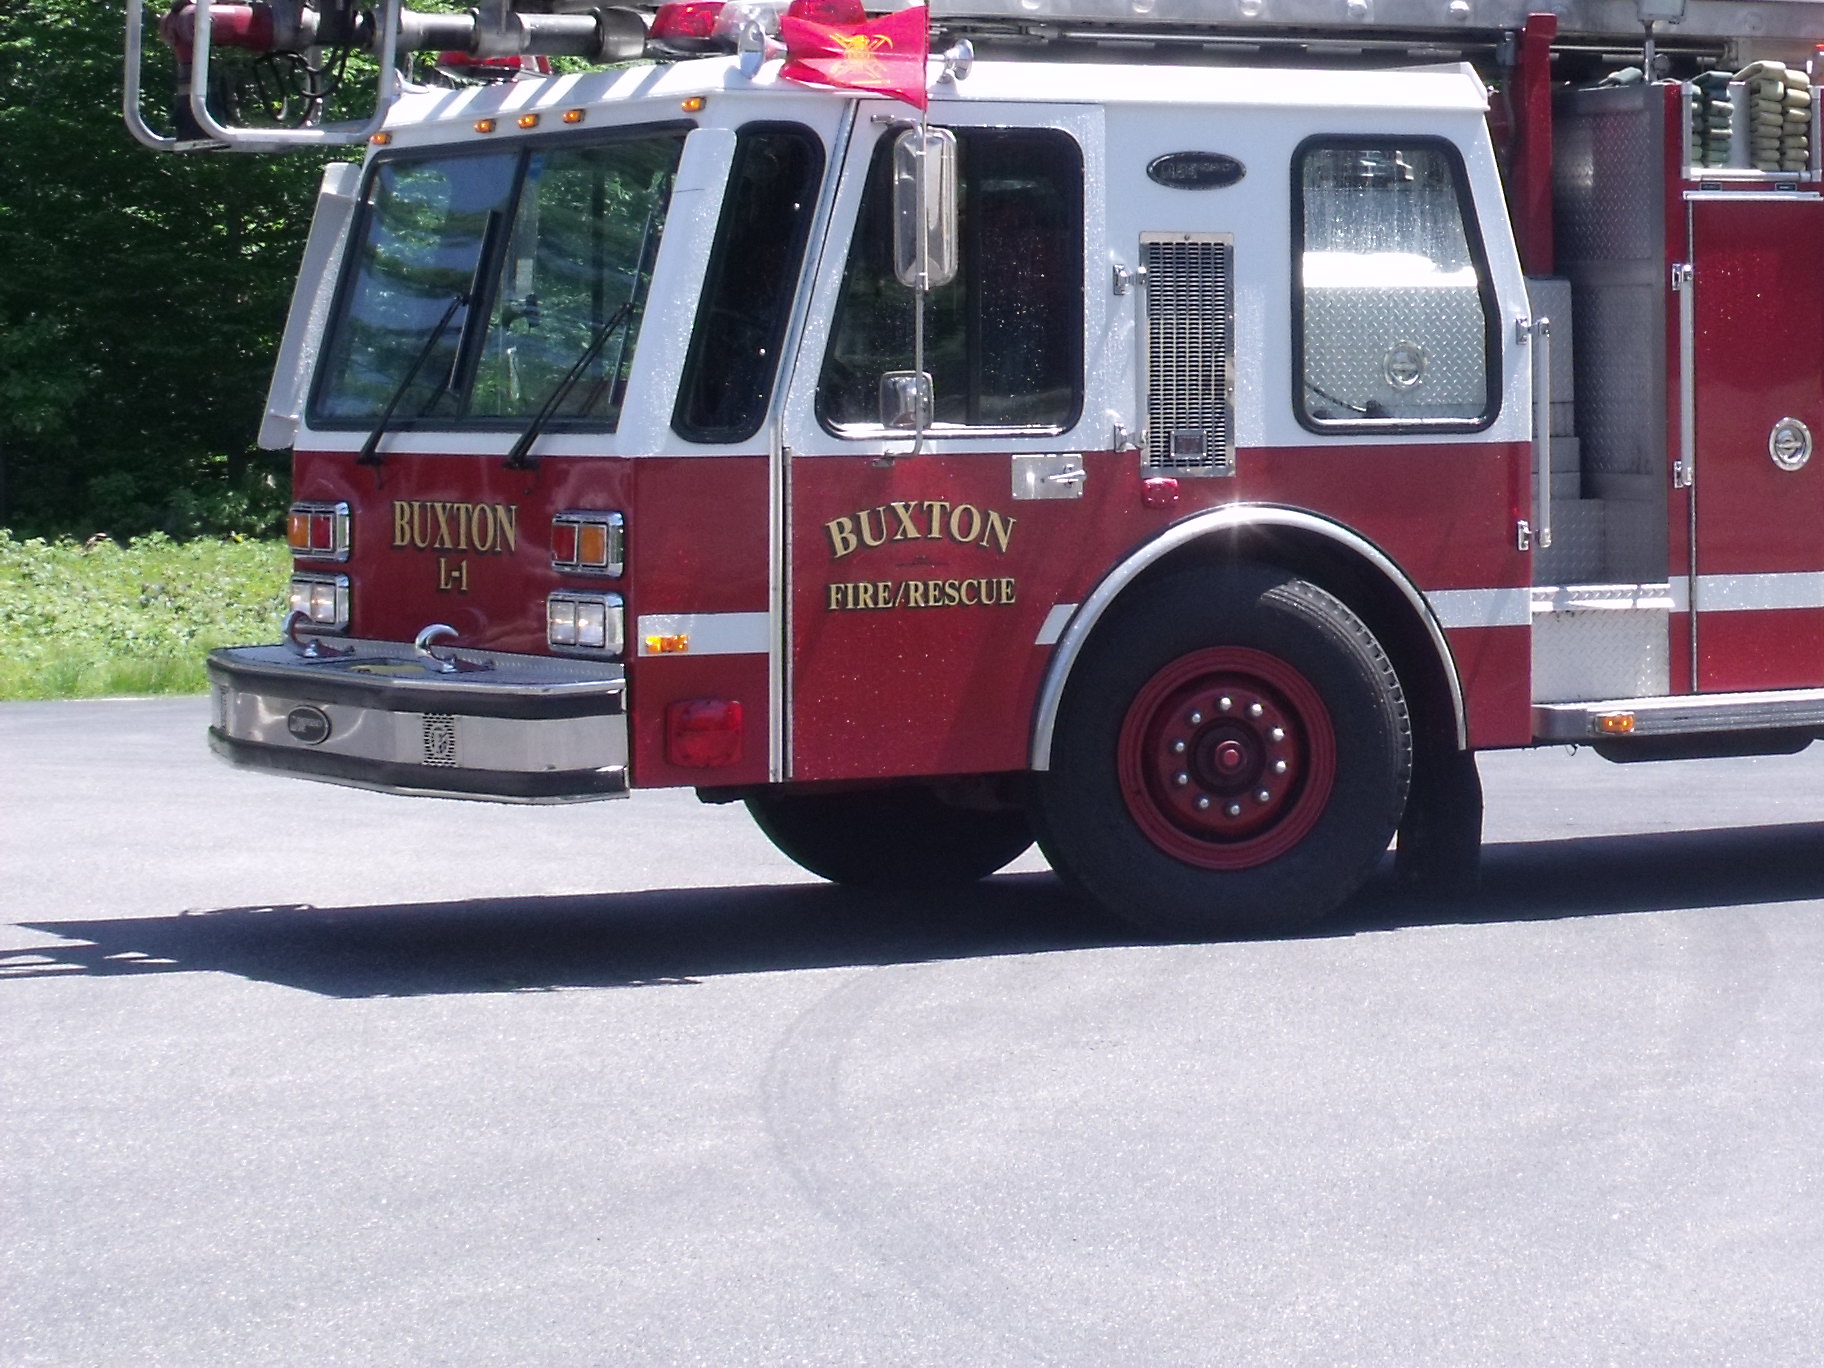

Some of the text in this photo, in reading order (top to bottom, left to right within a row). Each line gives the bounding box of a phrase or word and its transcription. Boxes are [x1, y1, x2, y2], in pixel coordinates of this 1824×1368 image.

[393, 500, 518, 552] BUXTON
[824, 500, 1017, 559] BUXTON
[439, 557, 469, 591] L-1
[828, 578, 1016, 611] FIRE/RESCUE
